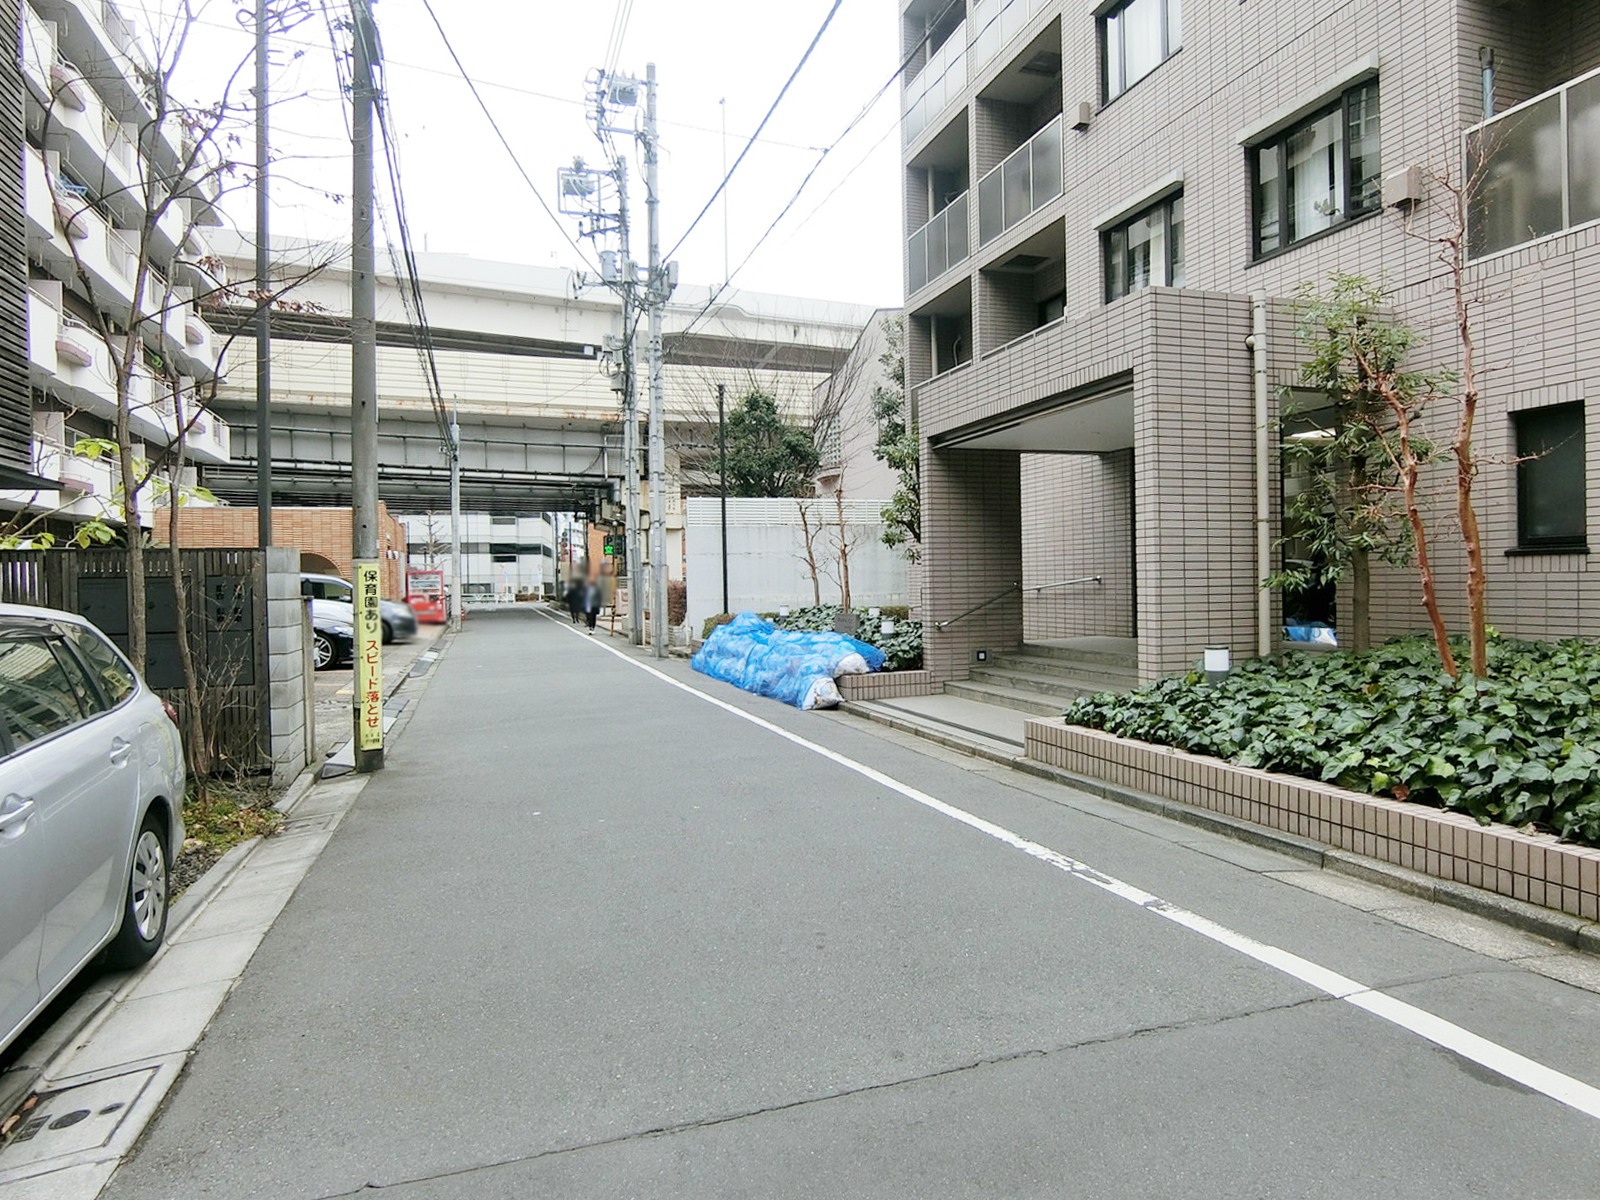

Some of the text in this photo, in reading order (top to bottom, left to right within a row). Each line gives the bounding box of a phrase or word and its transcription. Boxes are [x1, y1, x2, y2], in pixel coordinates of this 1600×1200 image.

[364, 570, 379, 633] 保育園あり
[366, 640, 379, 728] スピード落とせ
